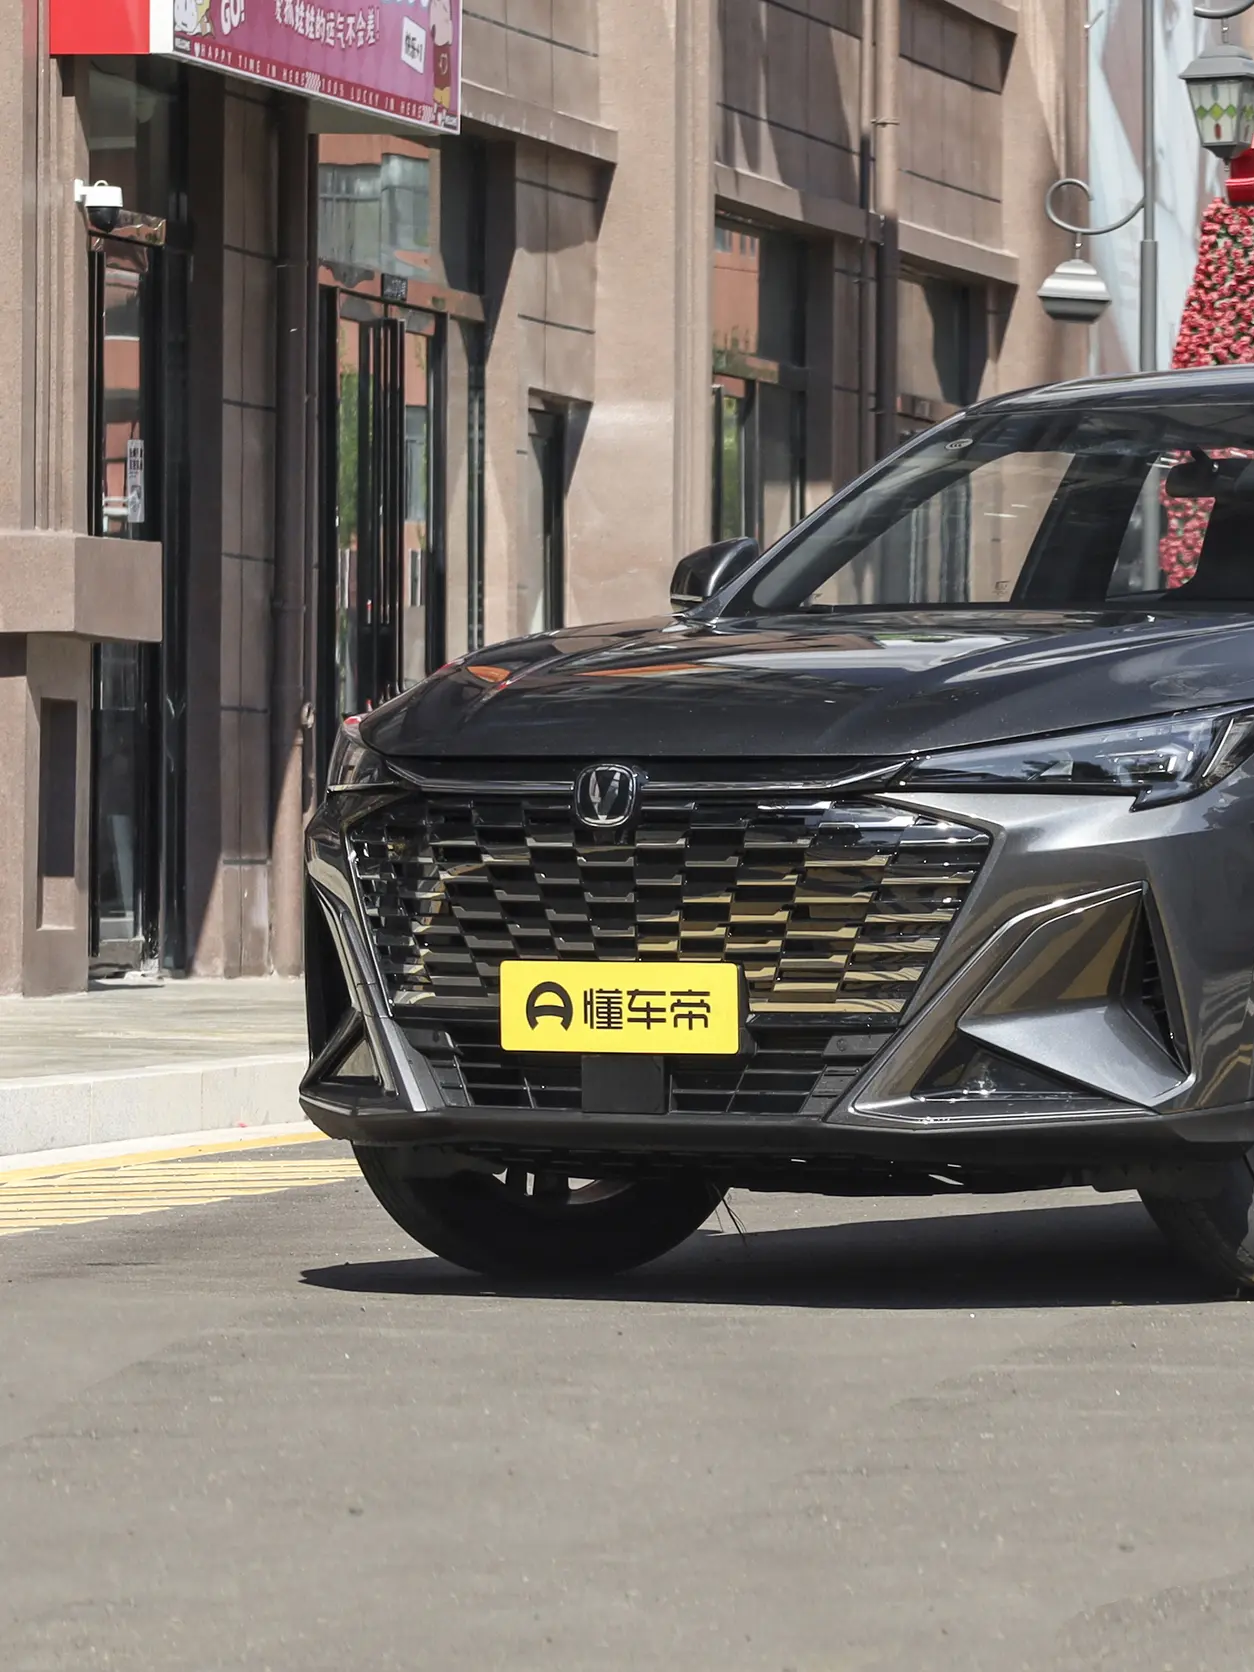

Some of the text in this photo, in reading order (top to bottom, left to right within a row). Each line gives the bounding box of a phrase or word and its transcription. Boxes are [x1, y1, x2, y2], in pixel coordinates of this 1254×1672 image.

[201, 43, 232, 65] HAPPY
[239, 54, 261, 74] TIME
[350, 86, 379, 108] LUCKY
[583, 988, 711, 1031] 懂车帝
